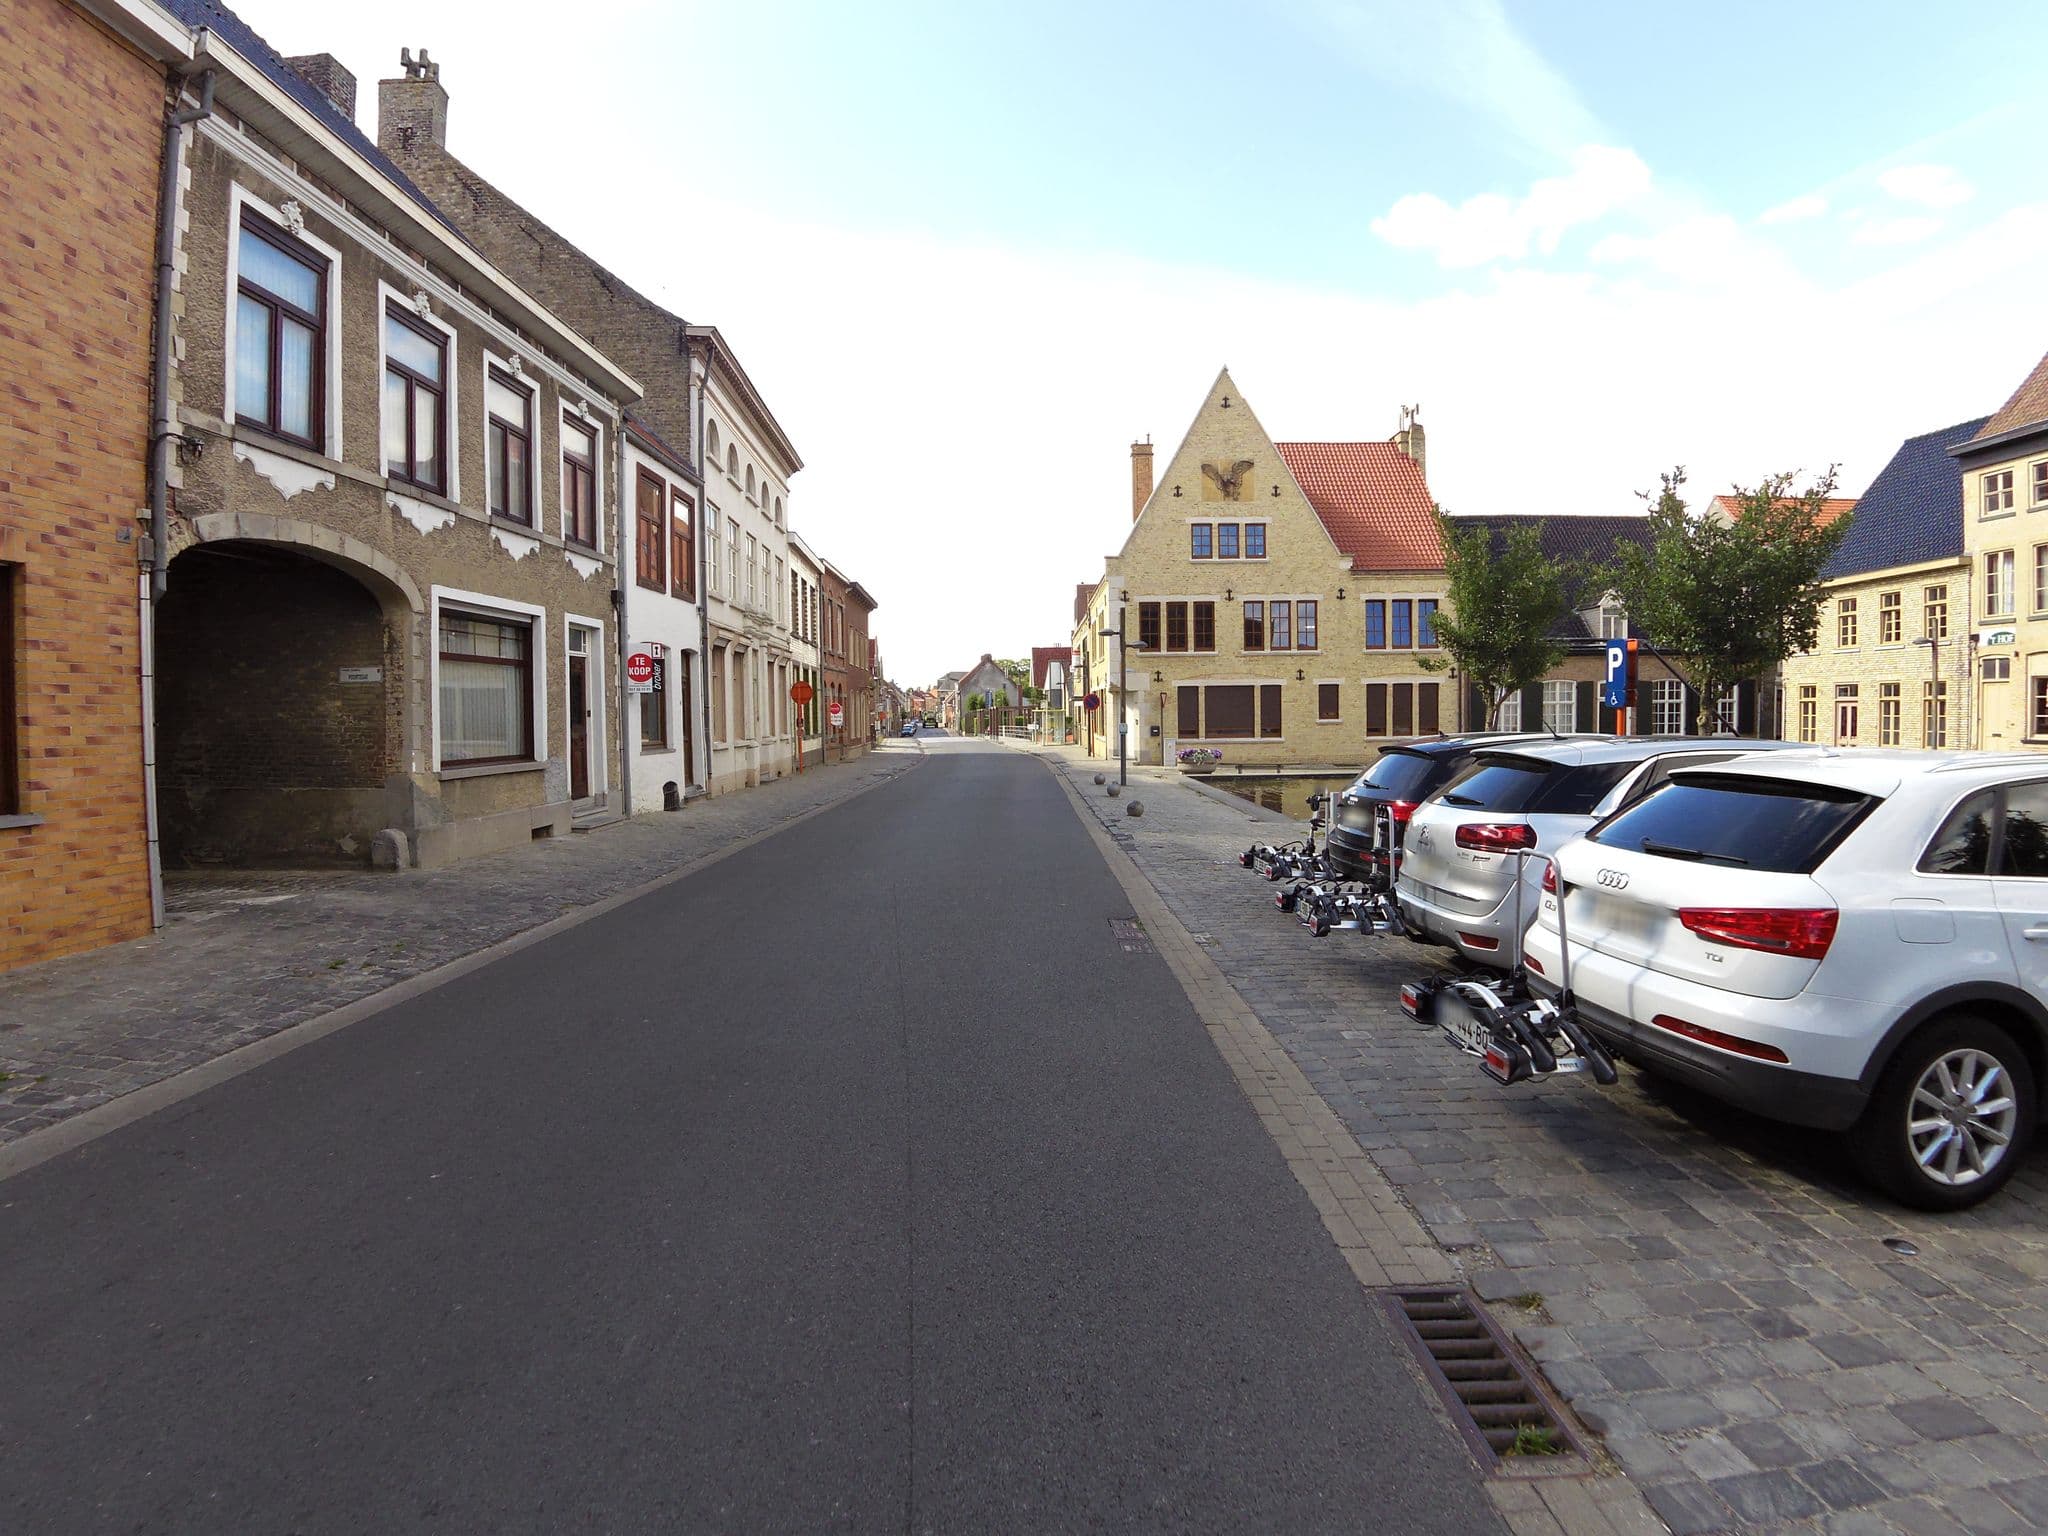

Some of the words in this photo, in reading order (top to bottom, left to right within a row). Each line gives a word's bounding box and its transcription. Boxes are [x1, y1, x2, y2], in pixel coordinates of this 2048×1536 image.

[635, 657, 645, 666] TE
[1608, 648, 1624, 682] P
[629, 667, 651, 676] KOOP
[652, 663, 662, 690] broker
